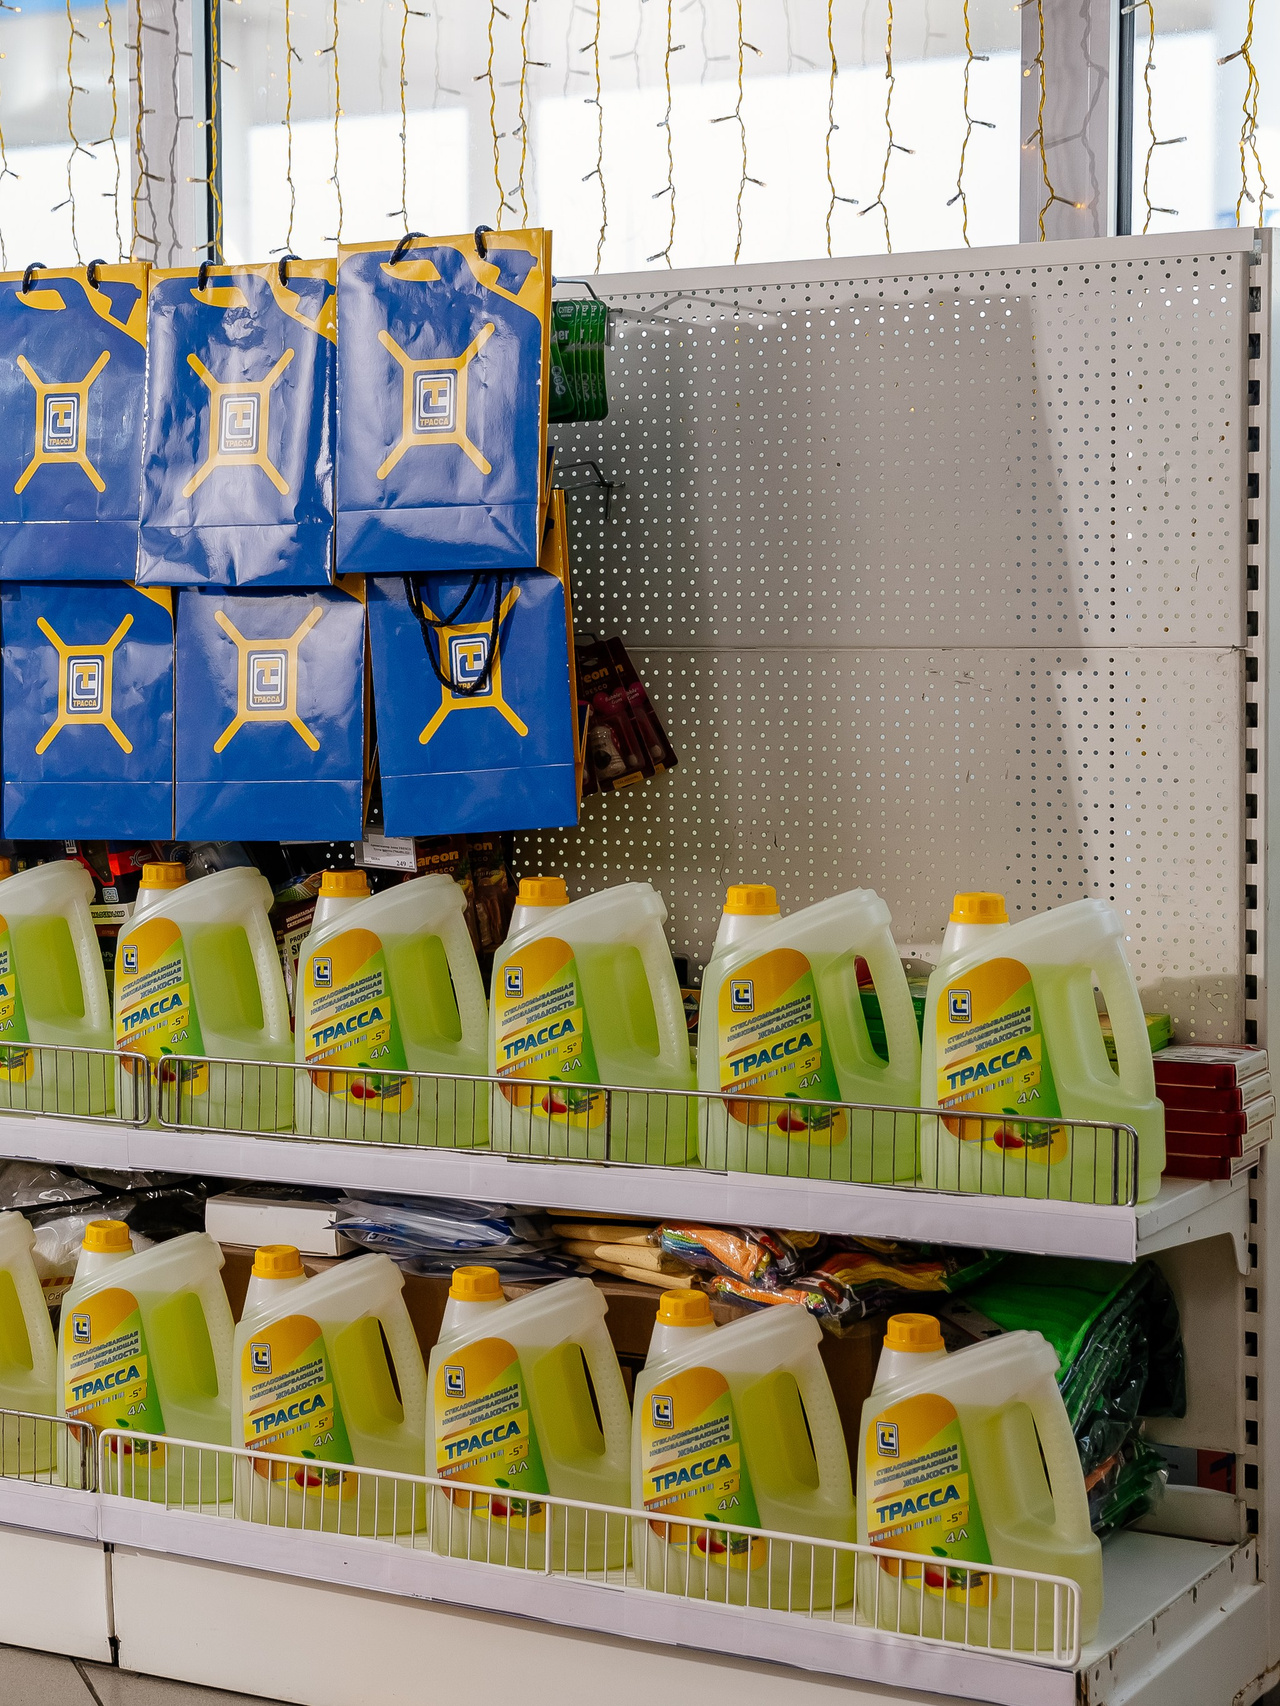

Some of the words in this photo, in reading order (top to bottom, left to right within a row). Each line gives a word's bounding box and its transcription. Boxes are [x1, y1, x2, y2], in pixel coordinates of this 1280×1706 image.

[420, 418, 449, 426] ТРАССА
[225, 440, 251, 448] ТРАССА
[253, 695, 280, 703] ТРАССА
[417, 850, 459, 867] areon
[123, 994, 182, 1030] ТРАССА
[313, 1008, 382, 1046] ТРАССА
[504, 1020, 574, 1058] ТРАССА
[731, 1034, 811, 1075] ТРАССА
[948, 1047, 1031, 1088] ТРАССА
[73, 1366, 139, 1400] ТРАССА
[253, 1396, 324, 1432] ТРАССА
[446, 1422, 519, 1458] ТРАССА
[653, 1455, 730, 1491] ТРАССА
[878, 1486, 958, 1522] ТРАССА
